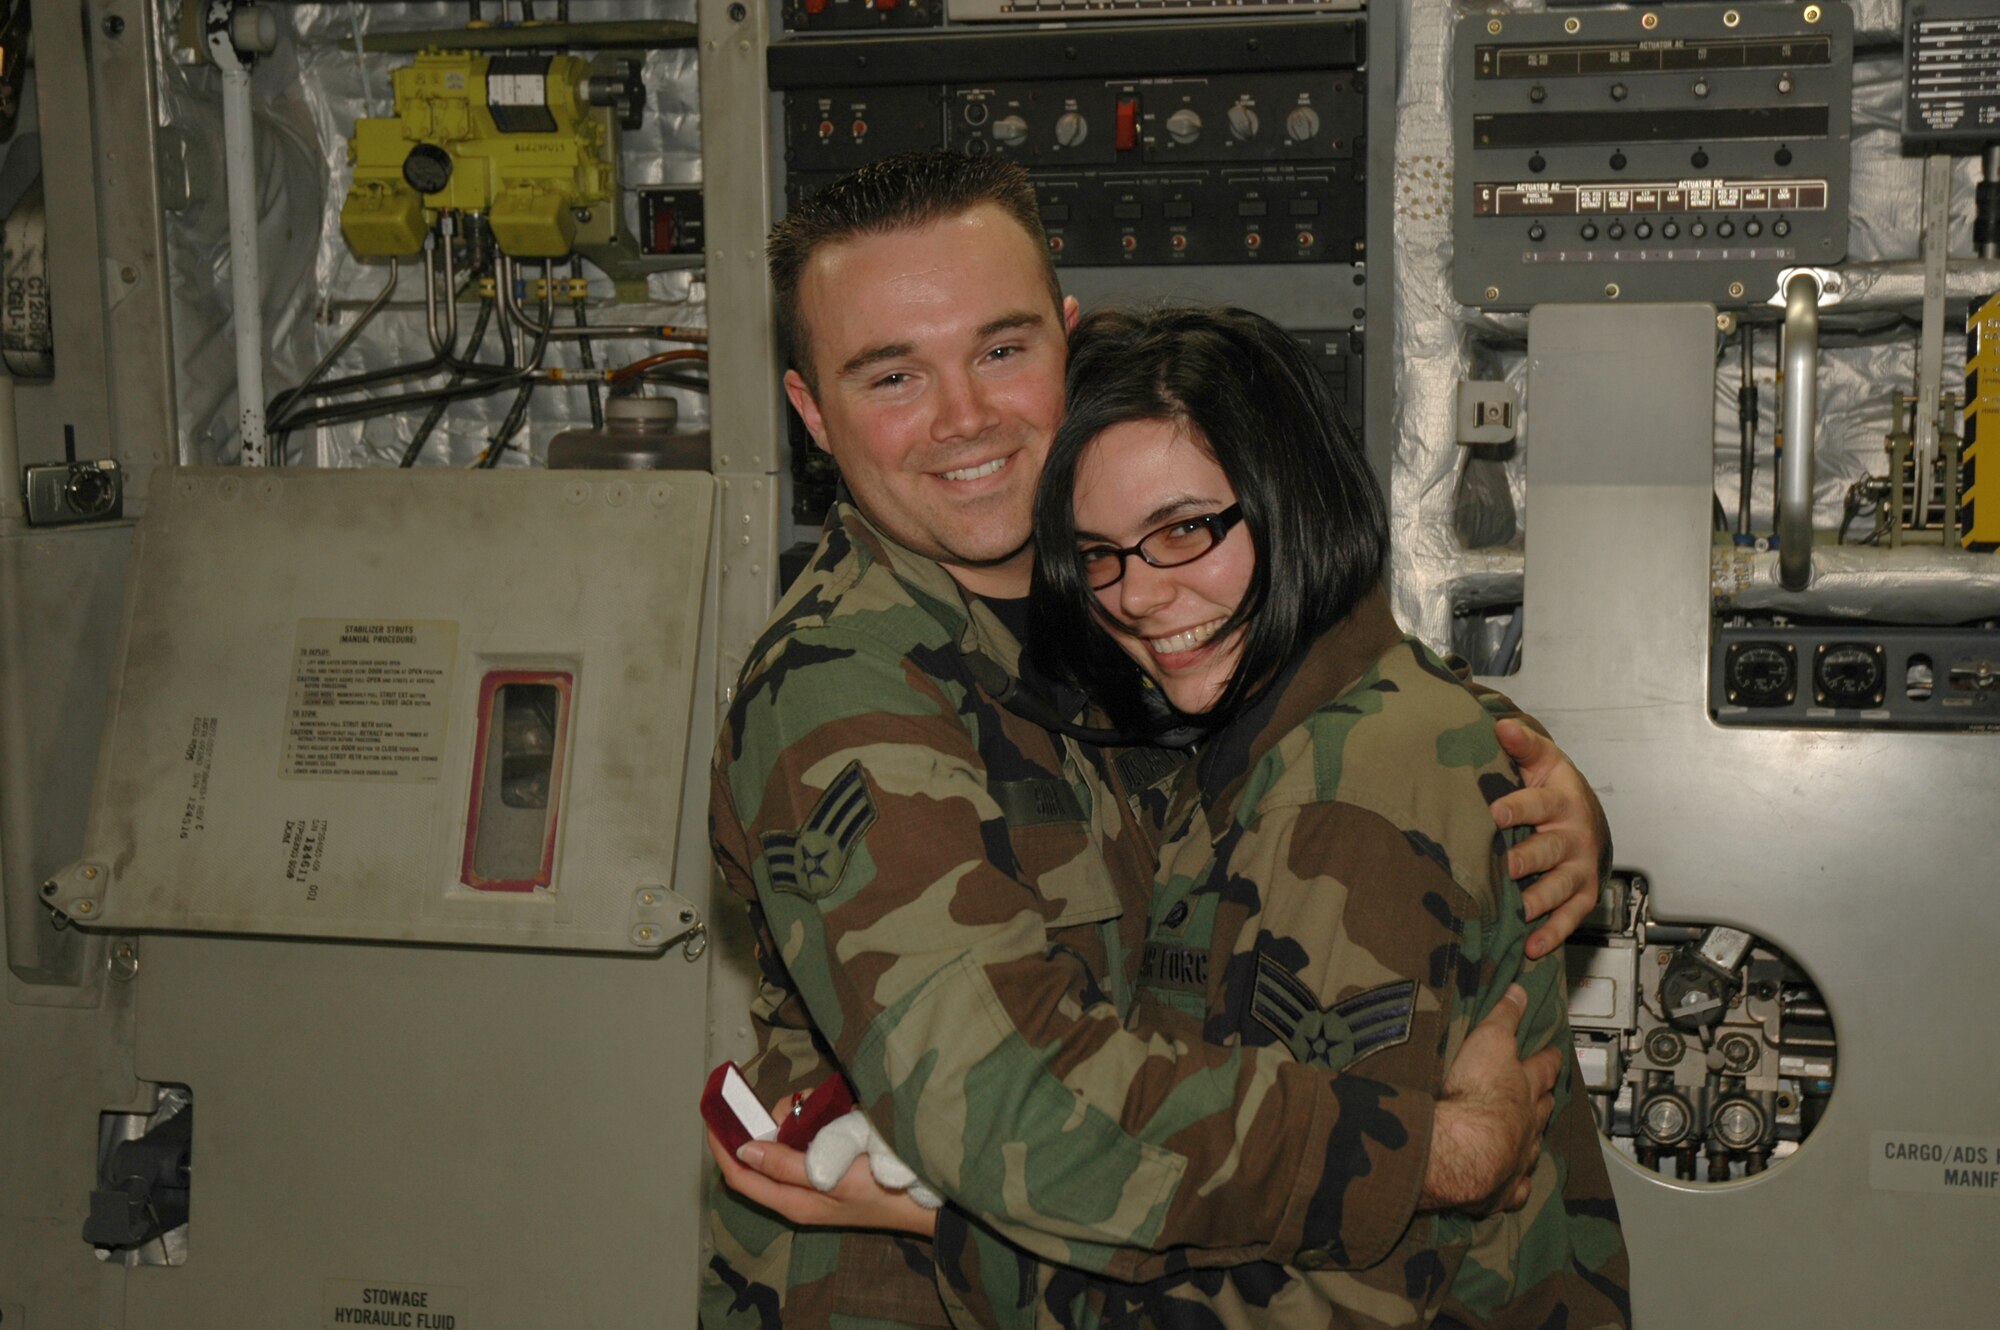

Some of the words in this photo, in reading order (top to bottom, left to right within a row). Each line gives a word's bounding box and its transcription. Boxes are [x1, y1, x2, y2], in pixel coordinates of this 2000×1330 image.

[1639, 41, 1672, 50] ACTUATOR
[1483, 52, 1490, 62] A
[1516, 183, 1549, 192] ACTUATOR
[1551, 182, 1560, 191] AC
[1678, 180, 1711, 189] ACTUATOR
[1714, 180, 1723, 188] DC
[1482, 189, 1489, 200] C
[1534, 253, 1538, 261] 1
[1560, 252, 1565, 261] 2
[1588, 252, 1592, 260] 3
[1614, 251, 1619, 260] 4
[1641, 251, 1646, 260] 5
[1668, 251, 1673, 259] 6
[1696, 250, 1700, 259] 7
[1723, 250, 1728, 259] 8
[1750, 250, 1755, 258] 9
[1776, 249, 1784, 258] 10
[344, 625, 384, 634] STABILIZER
[386, 625, 413, 634] STRUTS
[339, 635, 369, 644] (MANUAL
[372, 635, 417, 644] PROCEDURE)
[307, 884, 318, 901] 001
[1160, 946, 1207, 985] FORC
[1884, 1142, 1988, 1165] CARGO/ADS
[363, 1288, 428, 1308] STOWAGE
[336, 1308, 412, 1328] HYDRAULIC
[417, 1314, 455, 1330] FLUID
